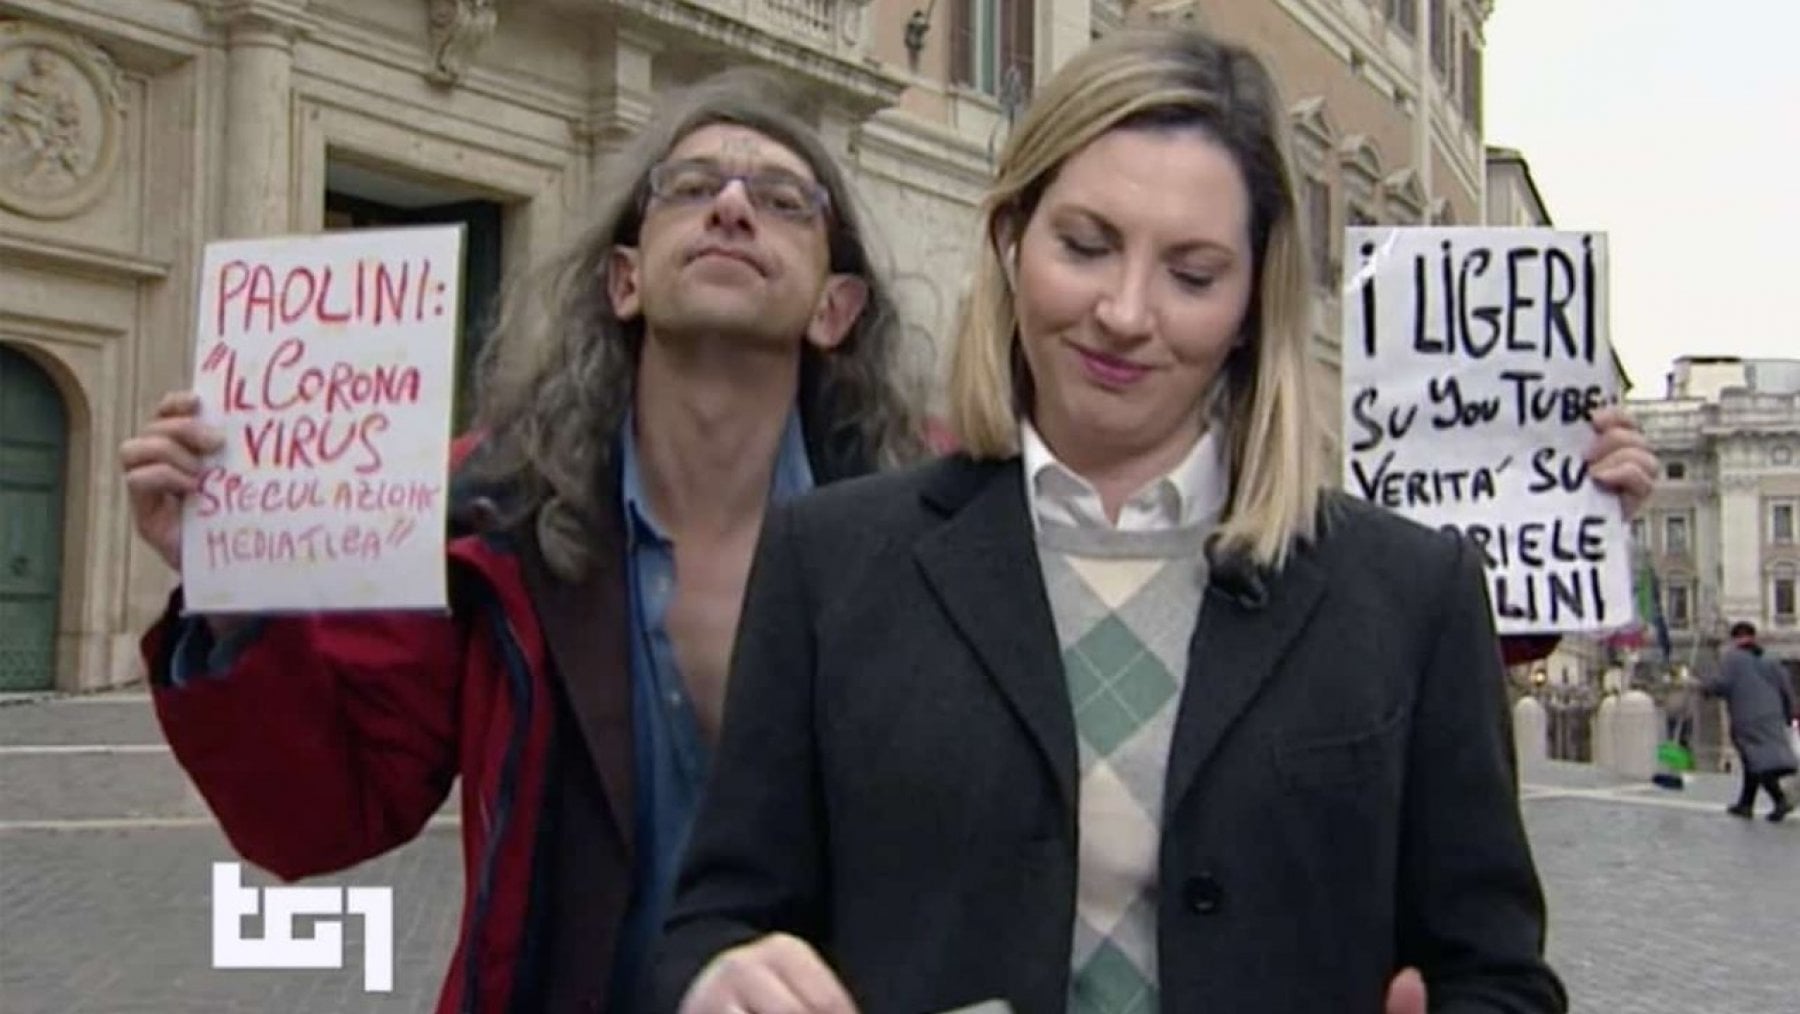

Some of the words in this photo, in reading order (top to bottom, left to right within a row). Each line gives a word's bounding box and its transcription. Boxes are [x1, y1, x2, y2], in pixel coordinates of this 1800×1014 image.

[217, 258, 446, 336] PAOLINI:
[262, 339, 422, 413] CORONA
[244, 412, 389, 474] VIRUS
[1351, 388, 1418, 452] SU
[1528, 447, 1589, 493] SU
[1440, 515, 1606, 569] RIELE
[1496, 566, 1605, 623] LINI
